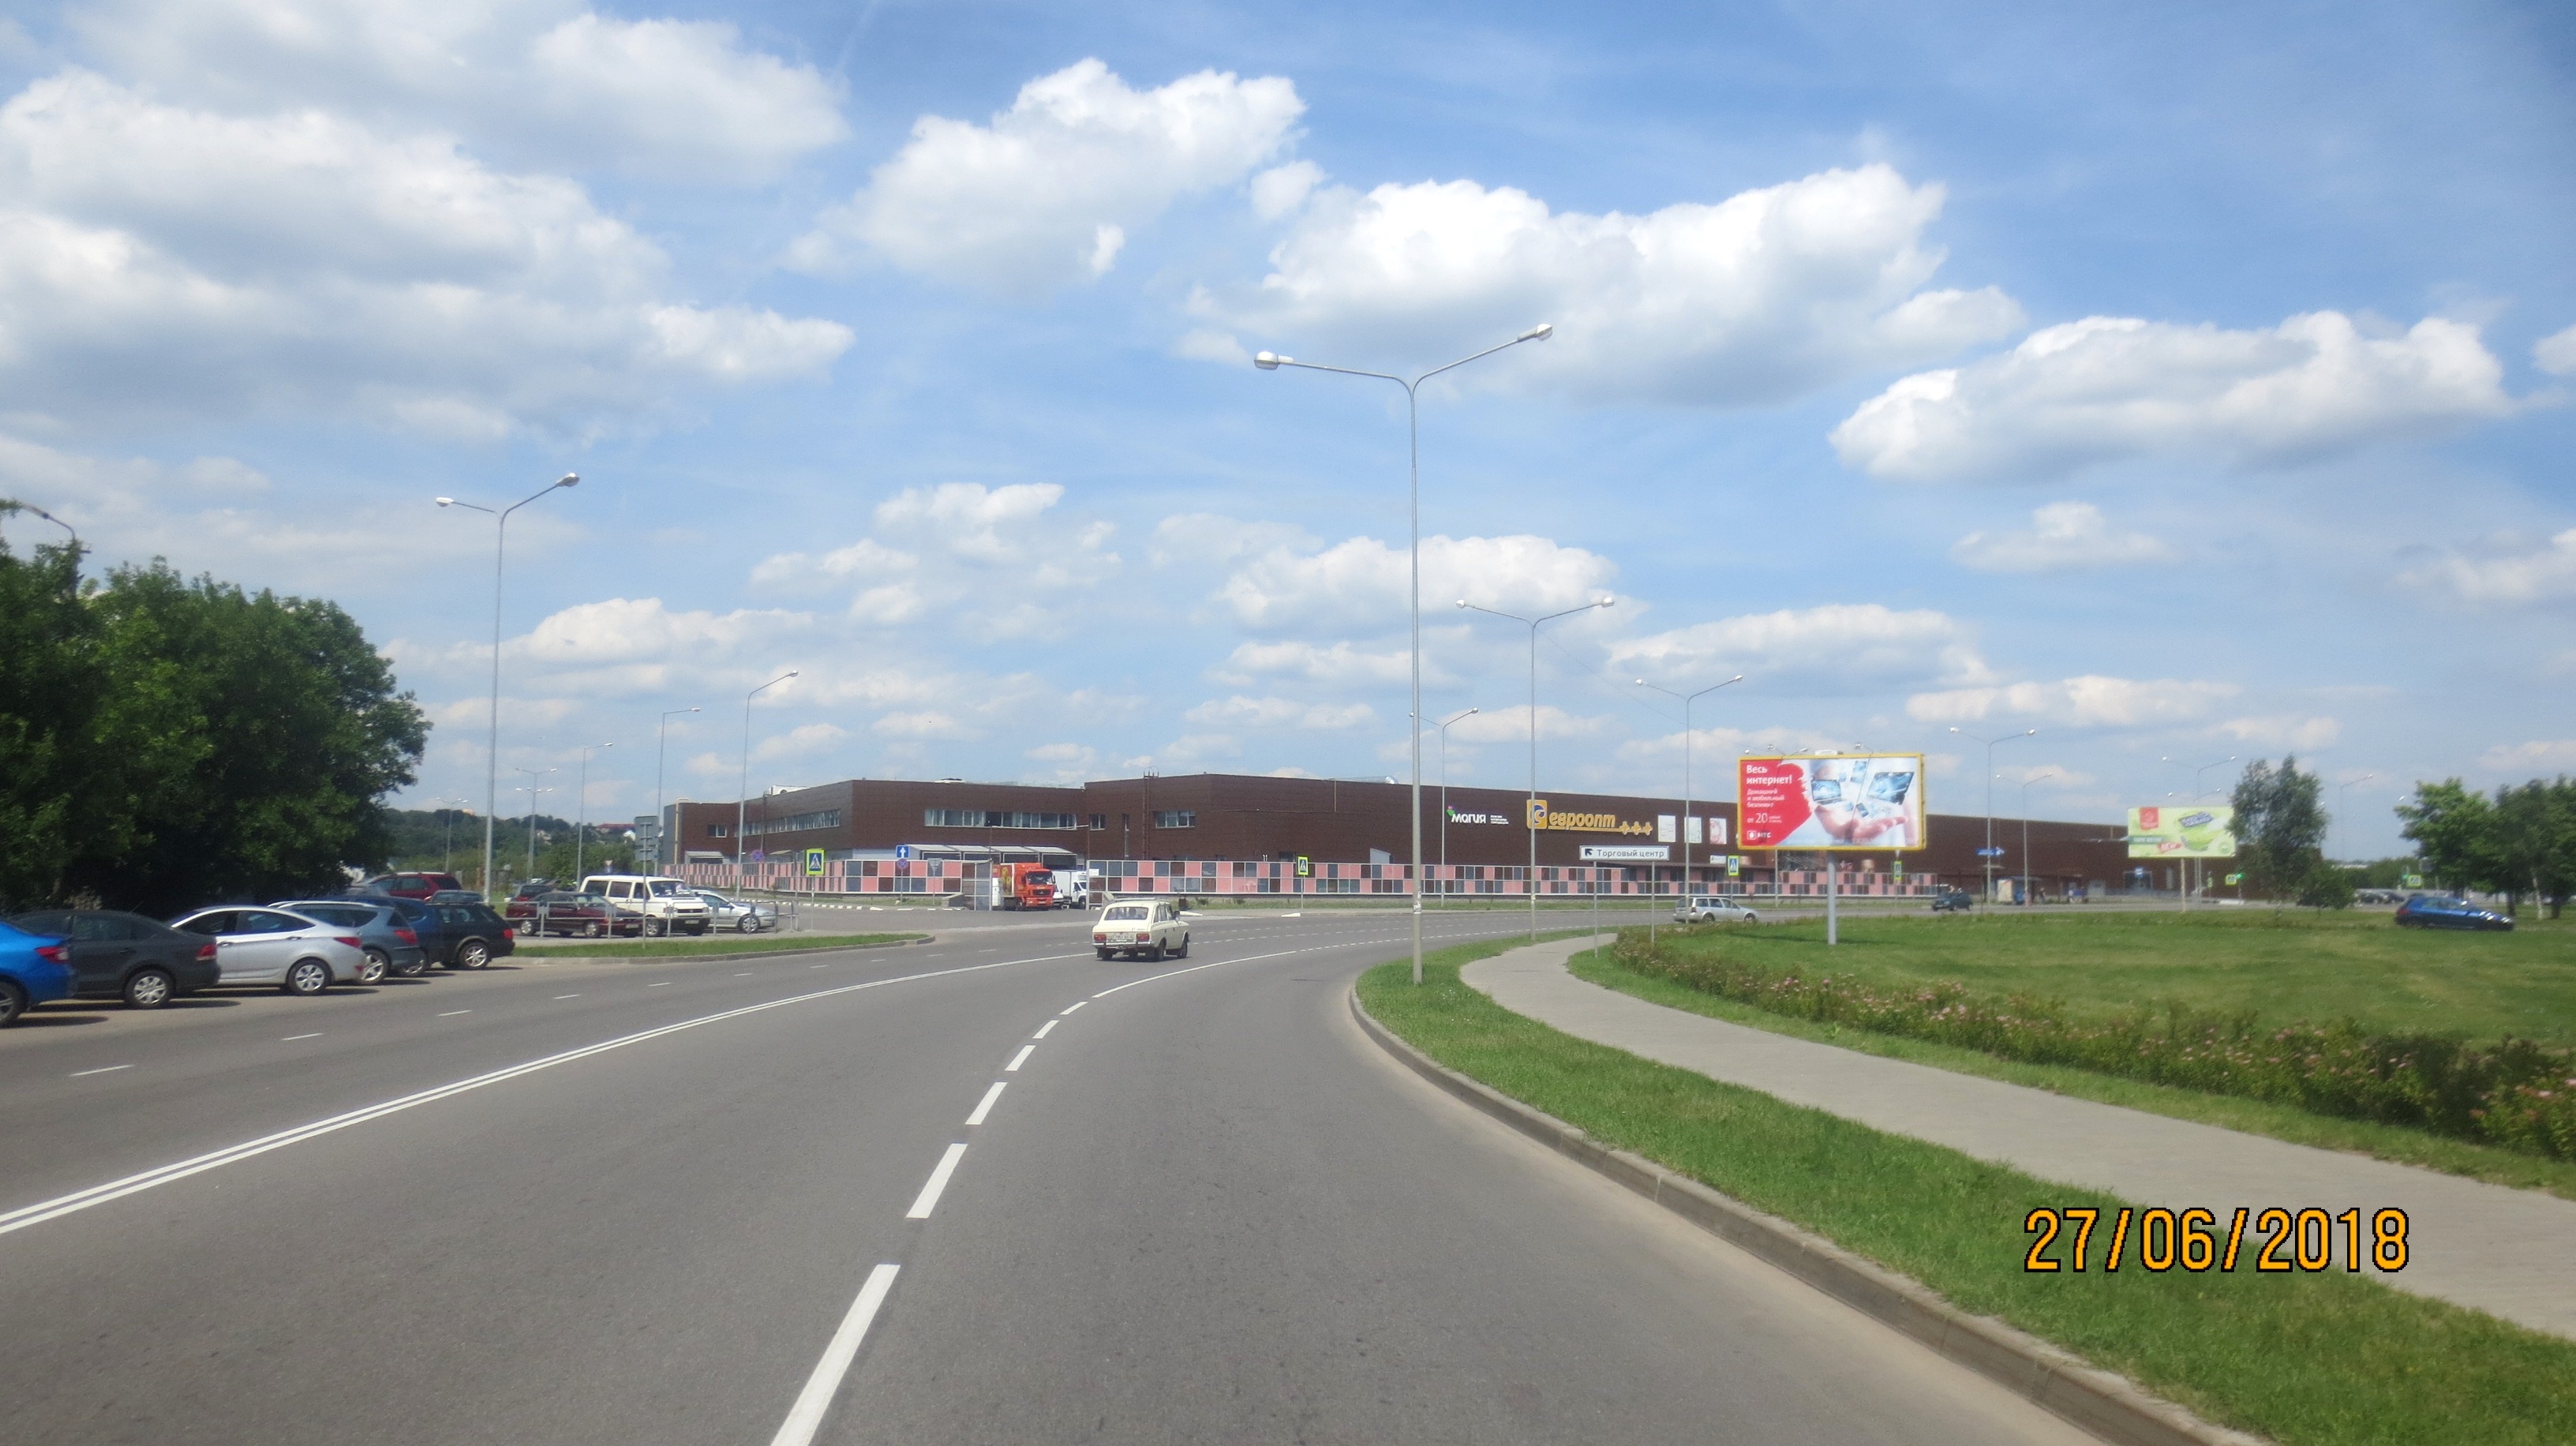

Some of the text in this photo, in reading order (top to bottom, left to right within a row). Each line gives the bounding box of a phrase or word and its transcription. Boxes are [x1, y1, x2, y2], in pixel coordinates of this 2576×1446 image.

[1747, 765, 1767, 774] Весь
[1747, 774, 1792, 786] интернет!
[1548, 811, 1616, 830] евроопт
[1755, 812, 1768, 823] 20
[1597, 848, 1664, 859] Торговый центр
